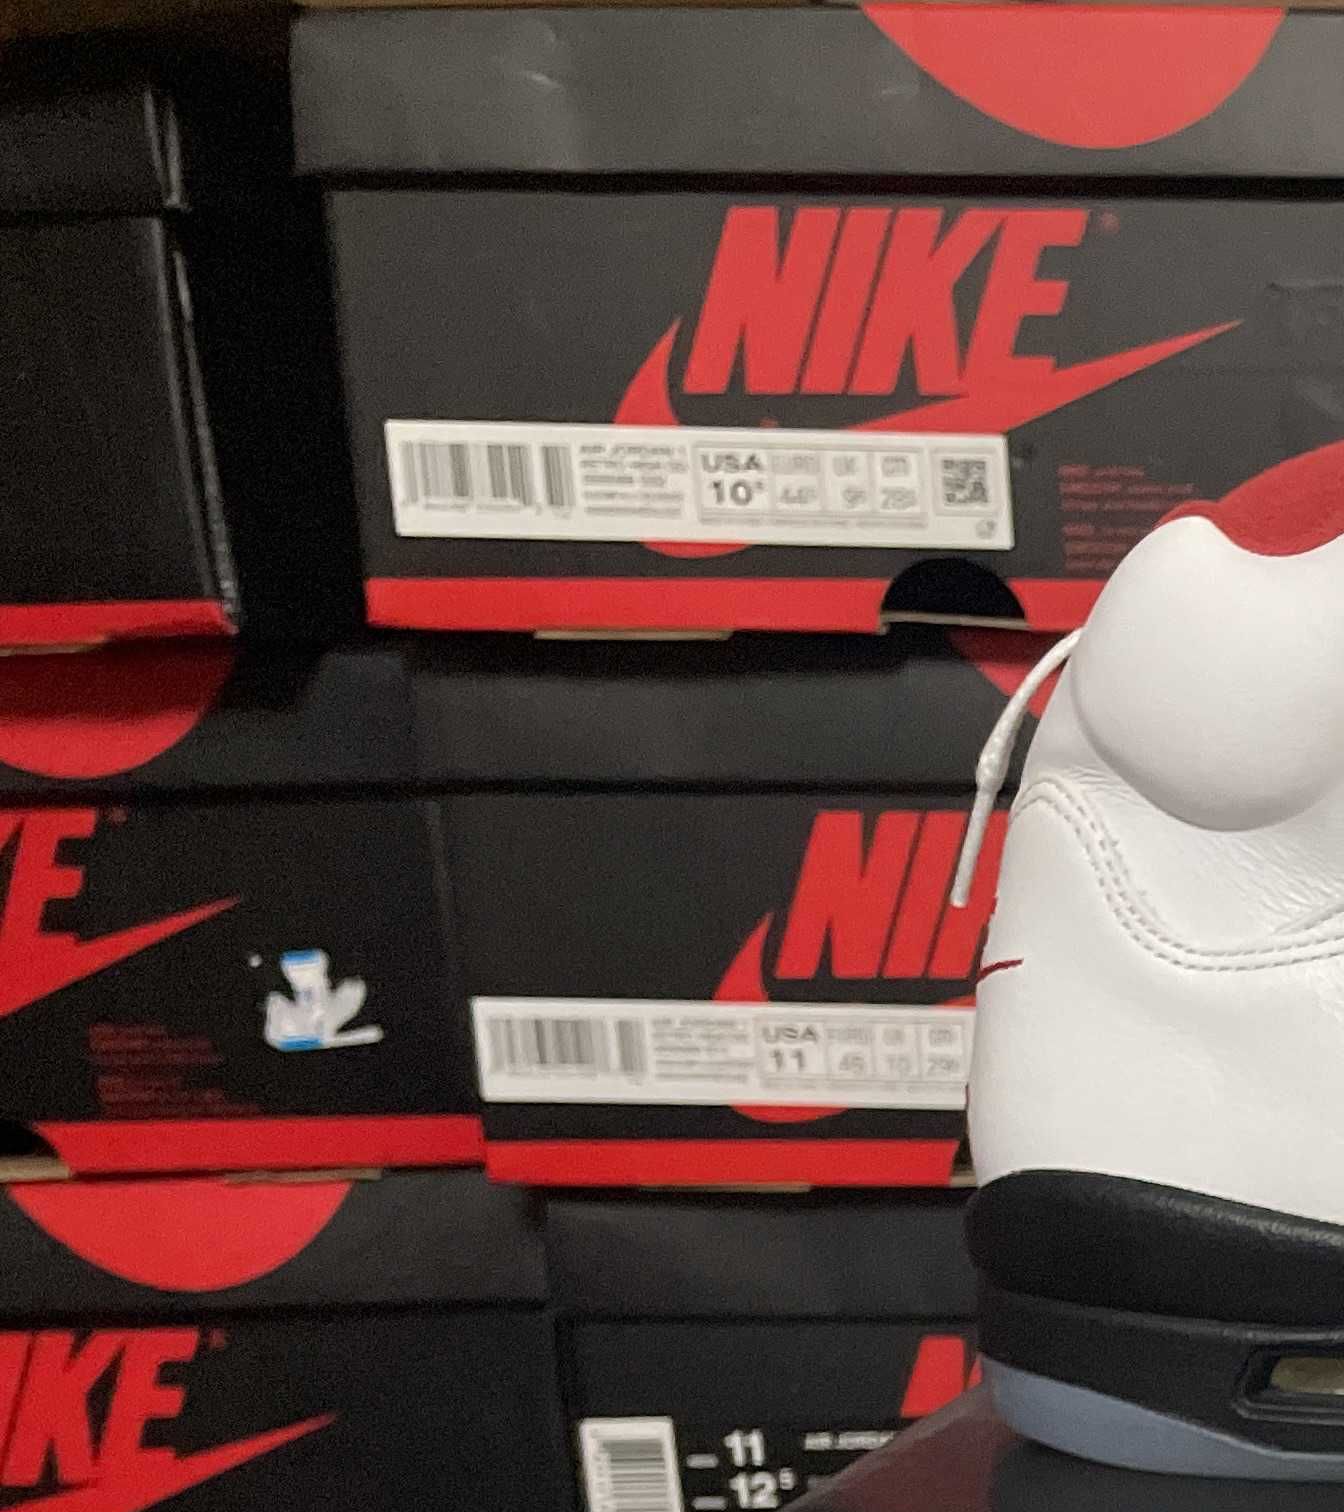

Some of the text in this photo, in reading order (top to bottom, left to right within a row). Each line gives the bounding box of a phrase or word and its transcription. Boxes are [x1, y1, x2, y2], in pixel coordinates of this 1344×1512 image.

[683, 206, 1089, 396] NIKE
[701, 453, 763, 474] USA
[775, 810, 1009, 980] NI
[760, 1026, 818, 1046] USA
[769, 1048, 807, 1074] 11
[724, 1428, 766, 1467] 11
